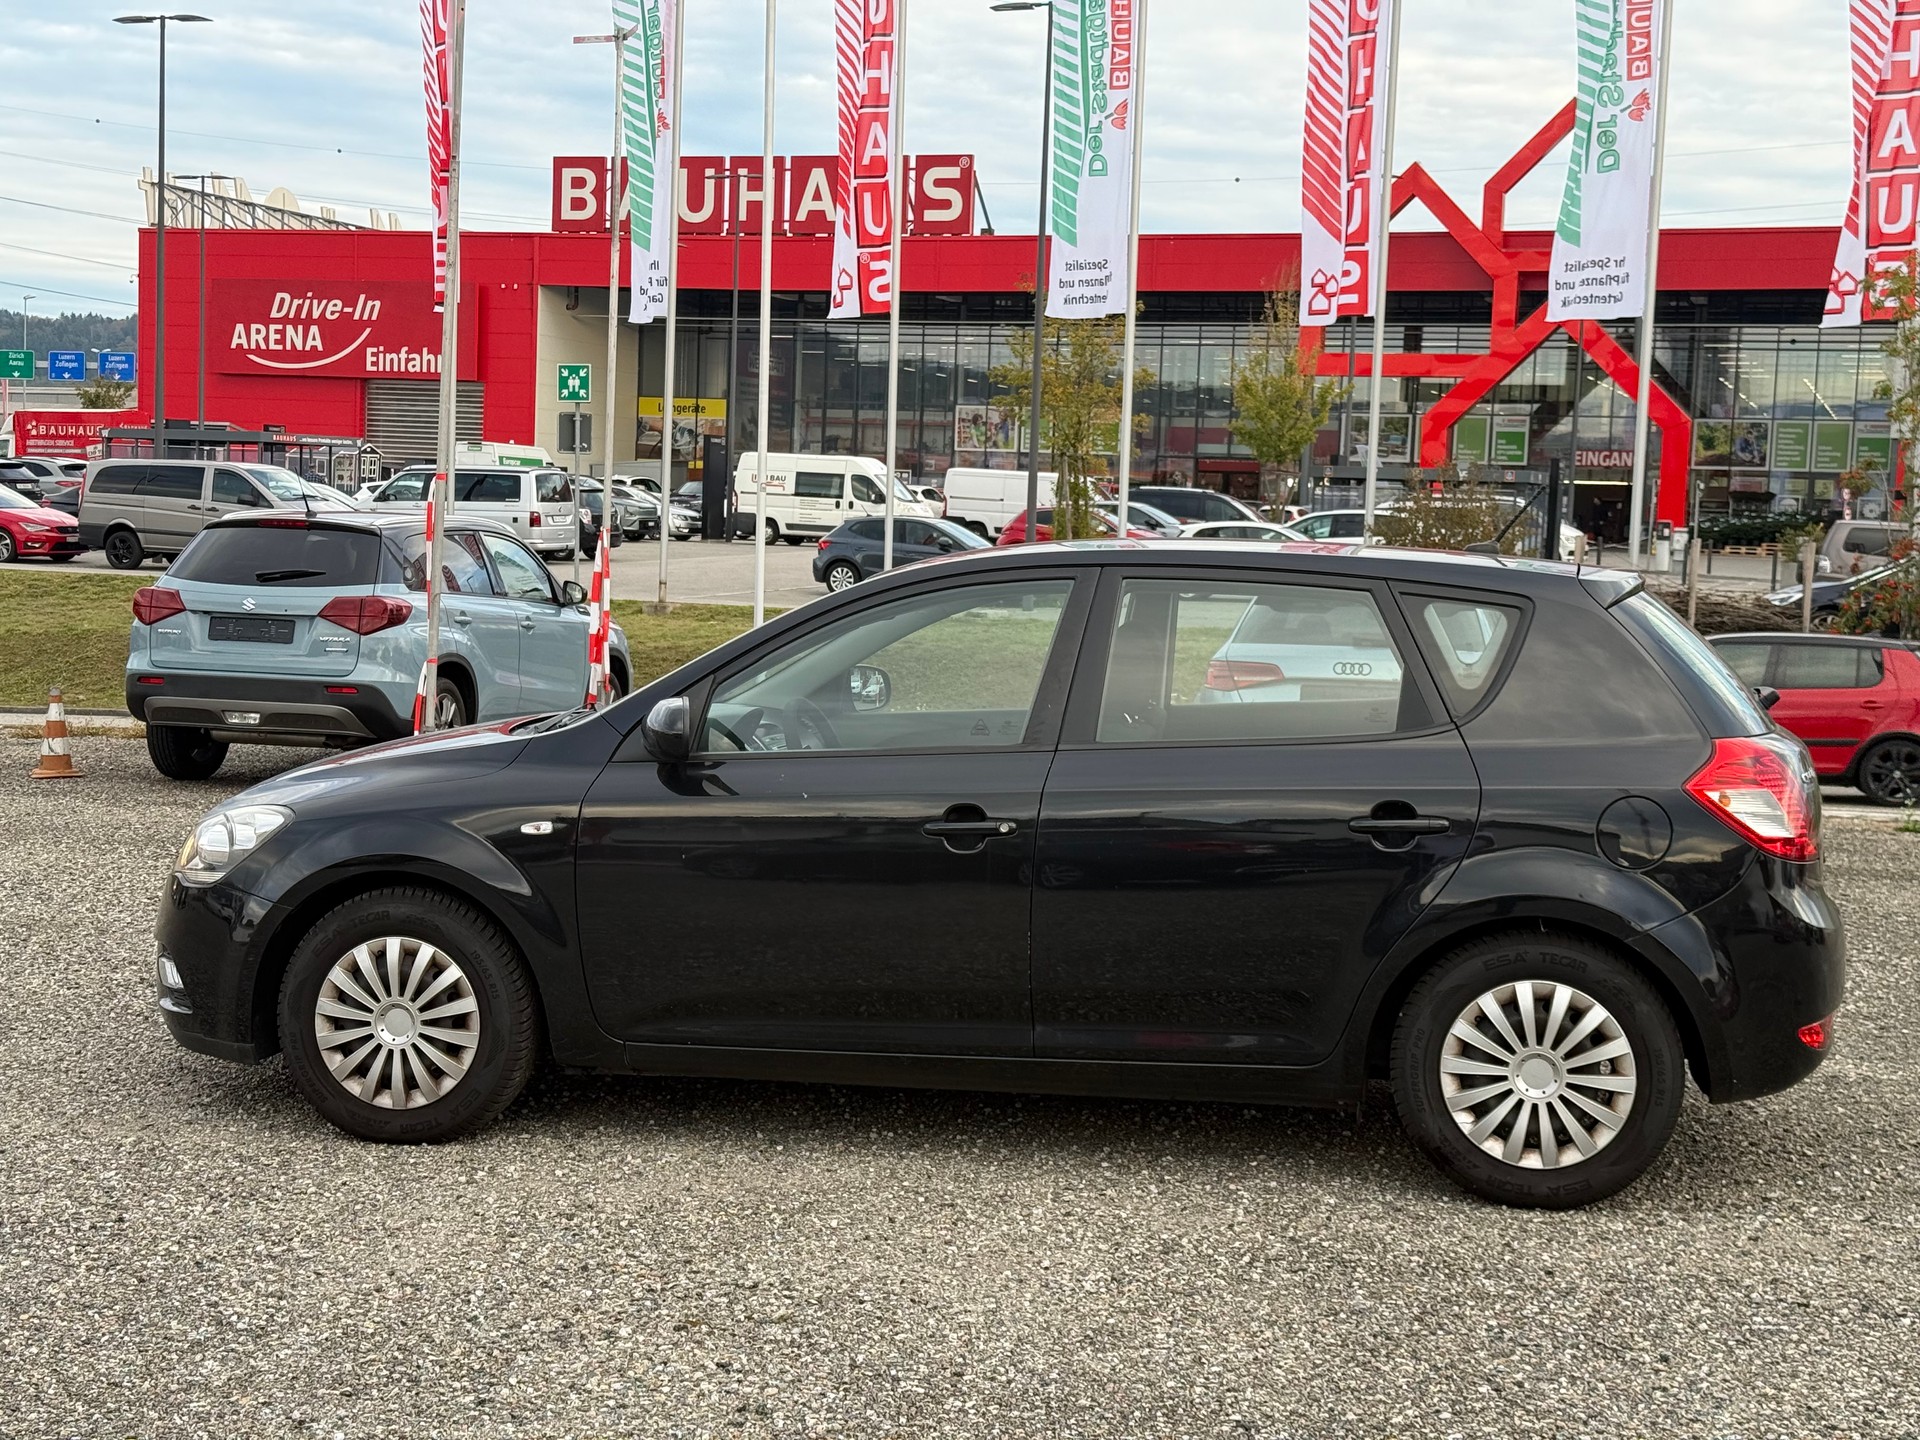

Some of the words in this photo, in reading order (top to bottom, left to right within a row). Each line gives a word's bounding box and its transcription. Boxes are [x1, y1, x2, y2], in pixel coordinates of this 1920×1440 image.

[270, 291, 381, 321] Drive-In
[230, 324, 324, 352] ARENA
[365, 347, 443, 374] Einfahr
[1575, 451, 1633, 467] EINGAN
